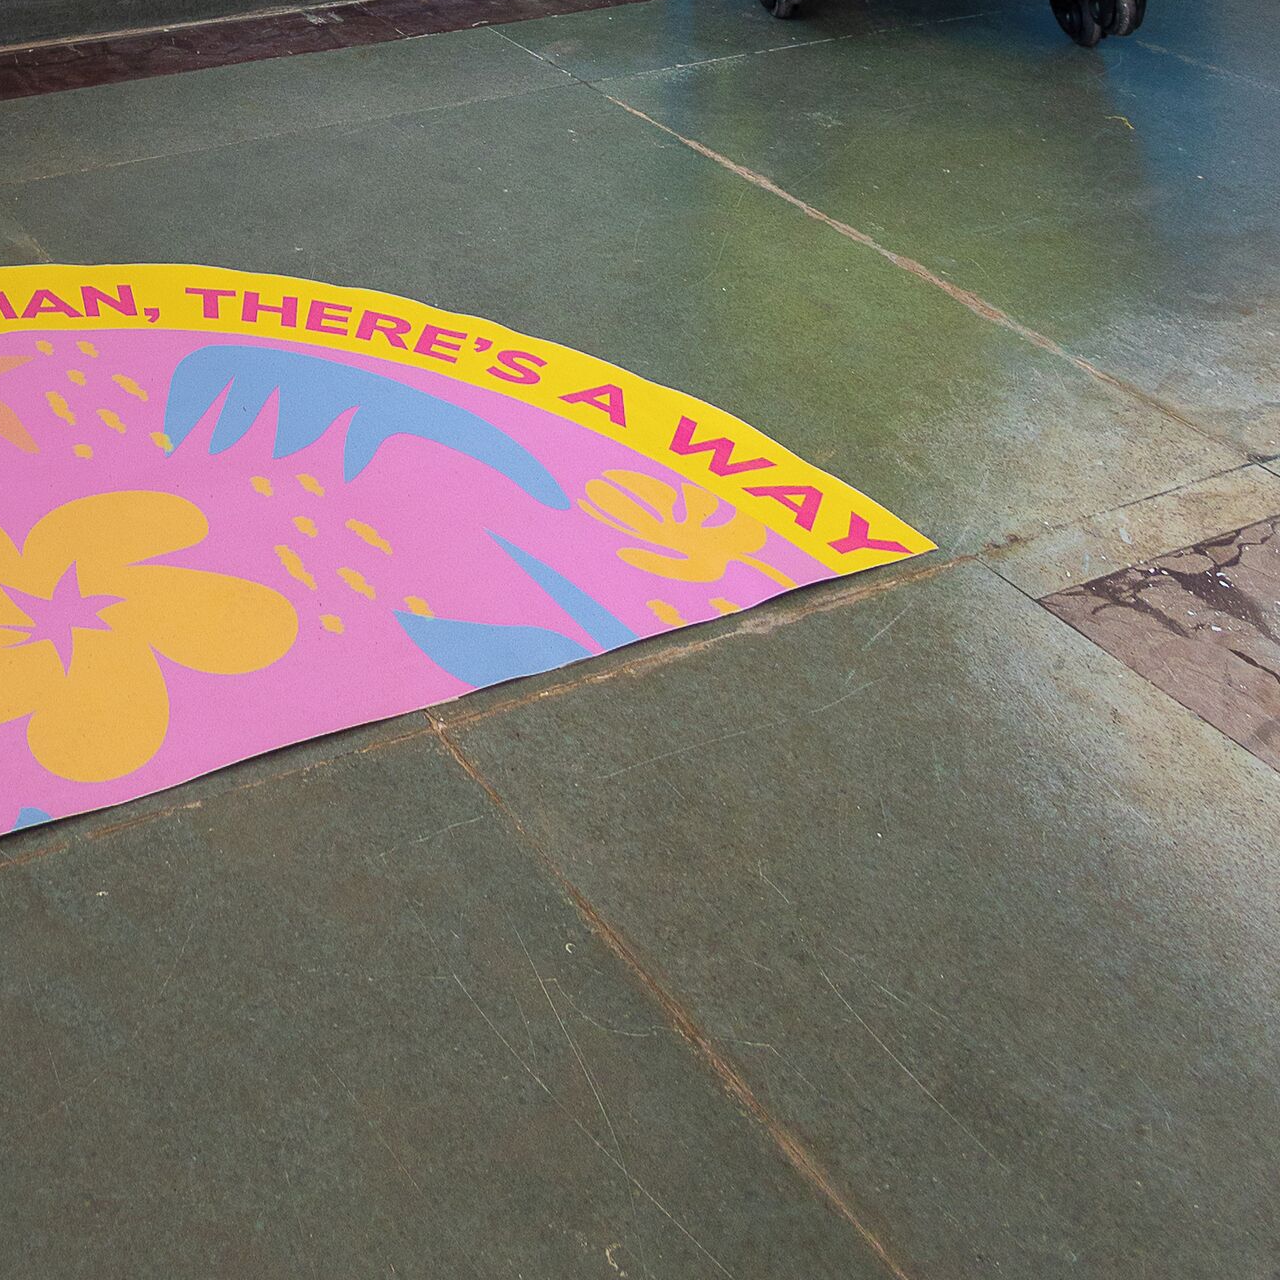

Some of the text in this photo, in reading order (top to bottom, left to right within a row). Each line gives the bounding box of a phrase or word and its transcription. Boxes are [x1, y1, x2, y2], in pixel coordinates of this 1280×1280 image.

[185, 287, 547, 385] THERE'S
[559, 384, 626, 427] A
[670, 415, 912, 554] WAY
